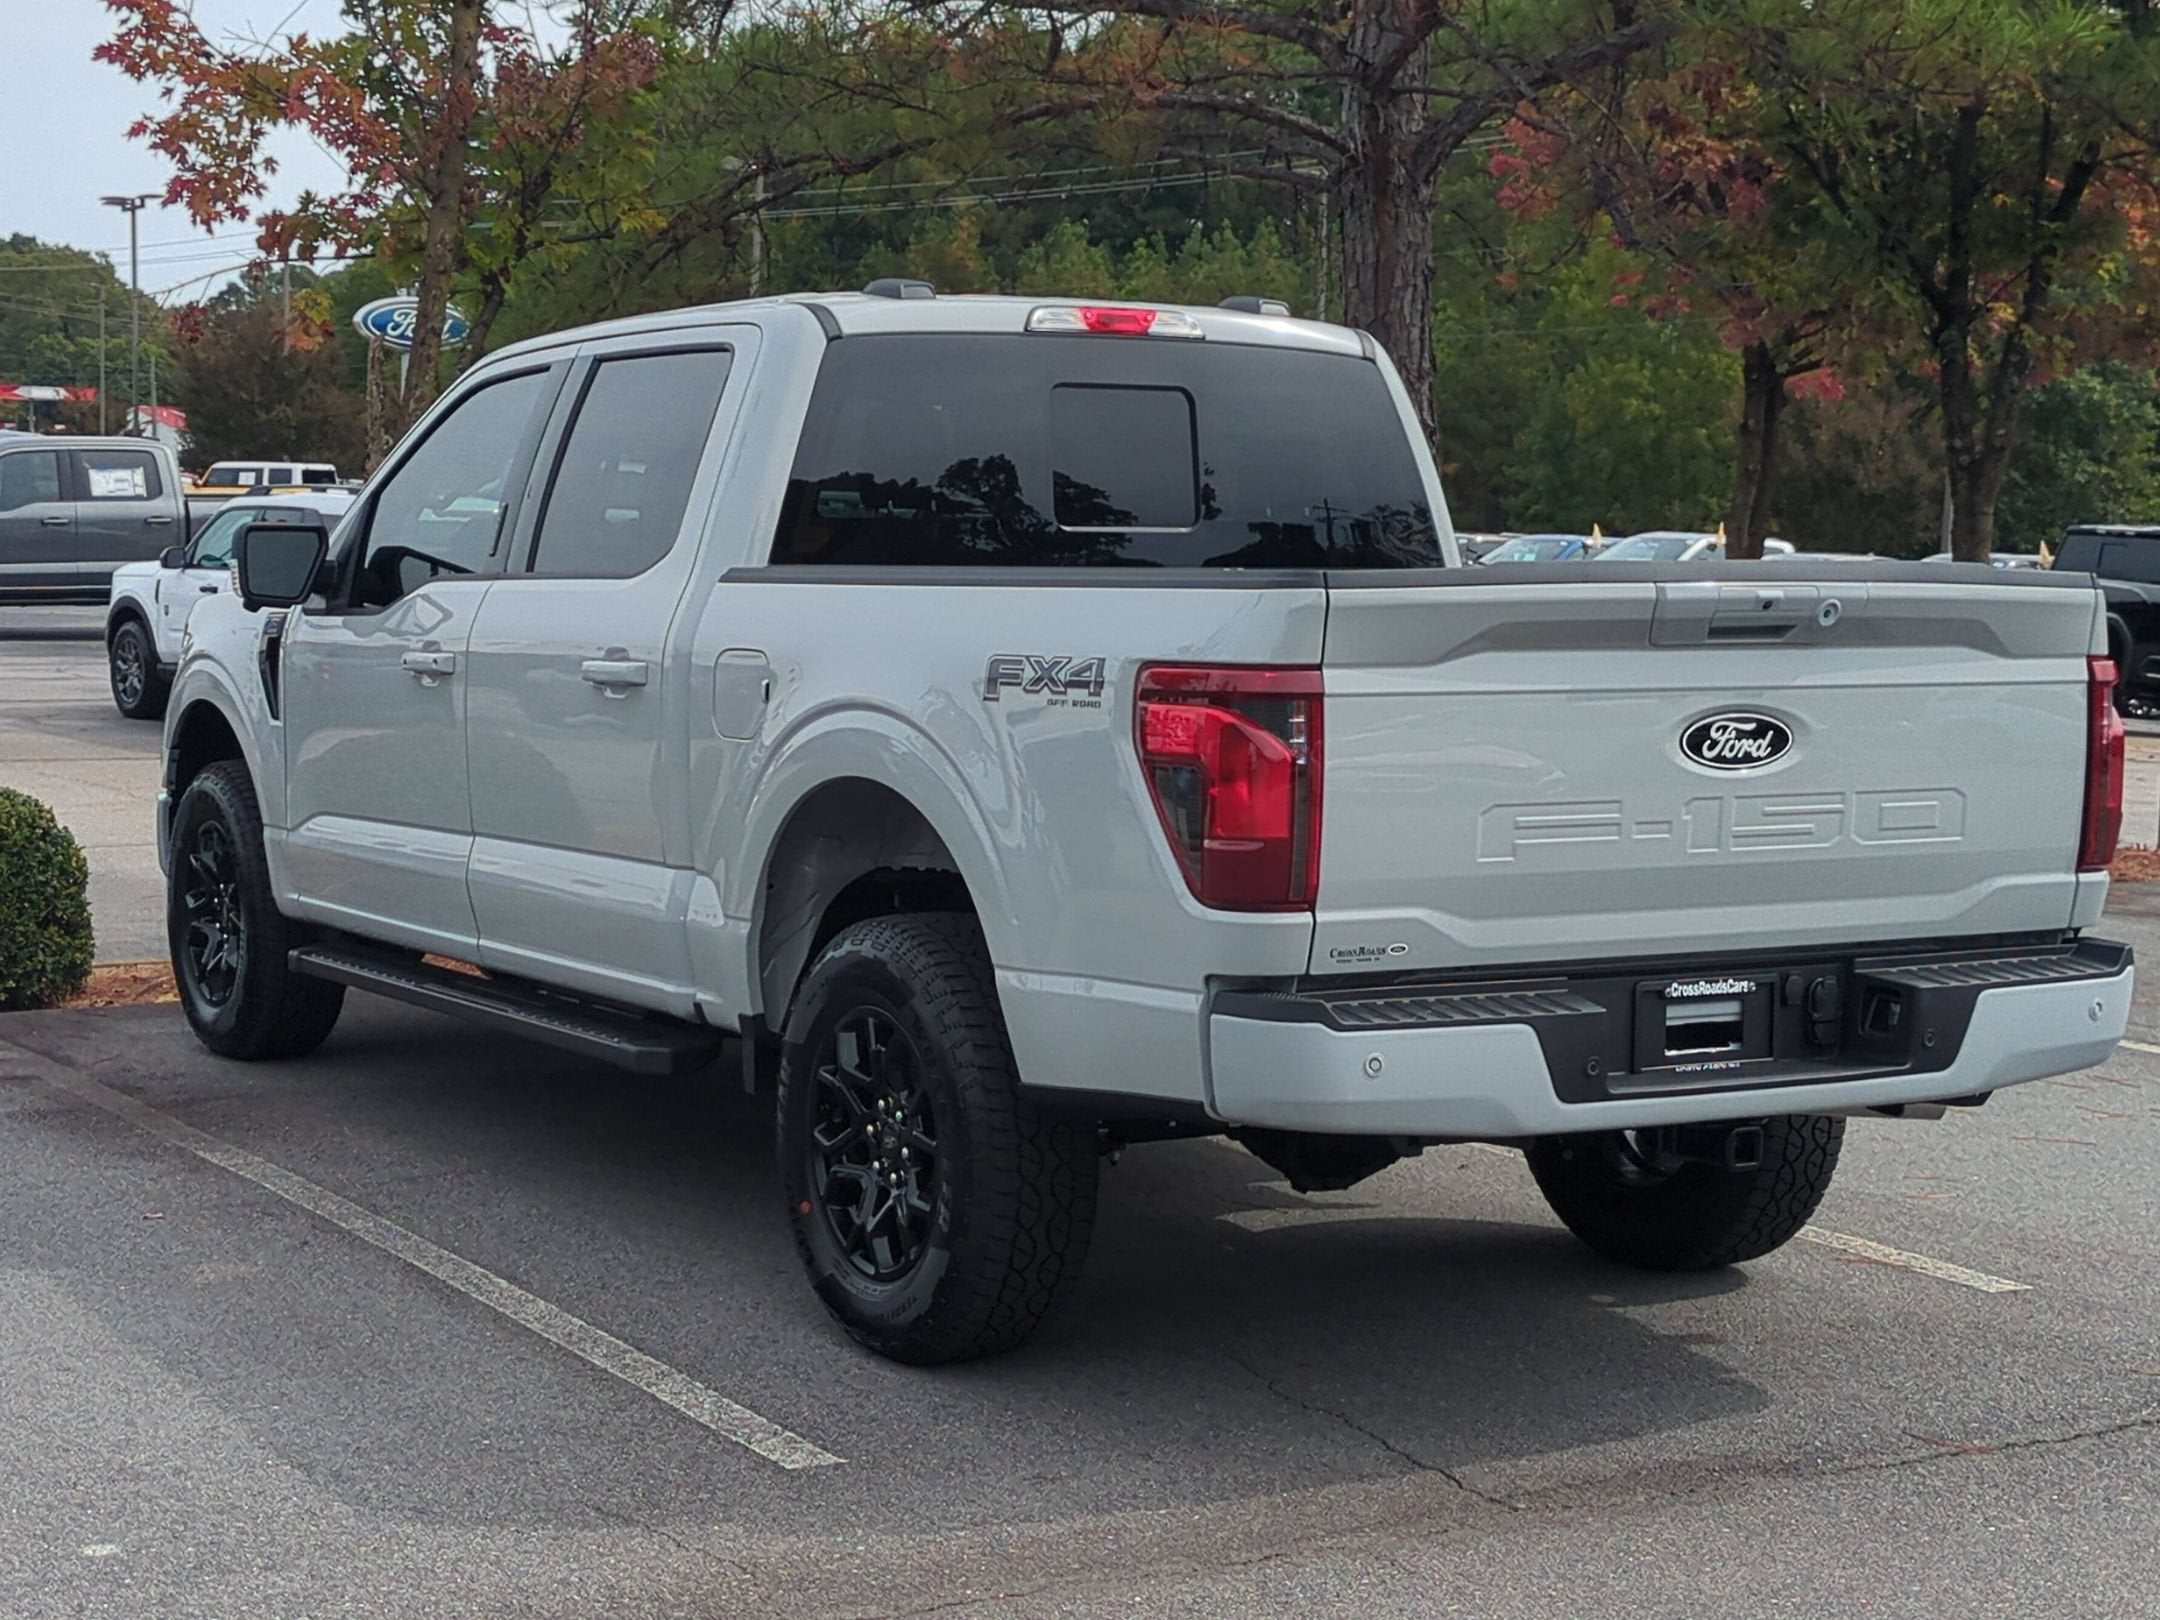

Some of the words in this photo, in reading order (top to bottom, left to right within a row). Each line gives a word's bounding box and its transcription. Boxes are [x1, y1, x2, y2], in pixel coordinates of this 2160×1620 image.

[386, 308, 454, 340] Fd
[982, 654, 1106, 702] FX4
[1047, 698, 1068, 706] OFF
[1071, 699, 1102, 709] ROAD
[1702, 721, 1774, 758] Ford
[1476, 787, 1967, 863] F-150
